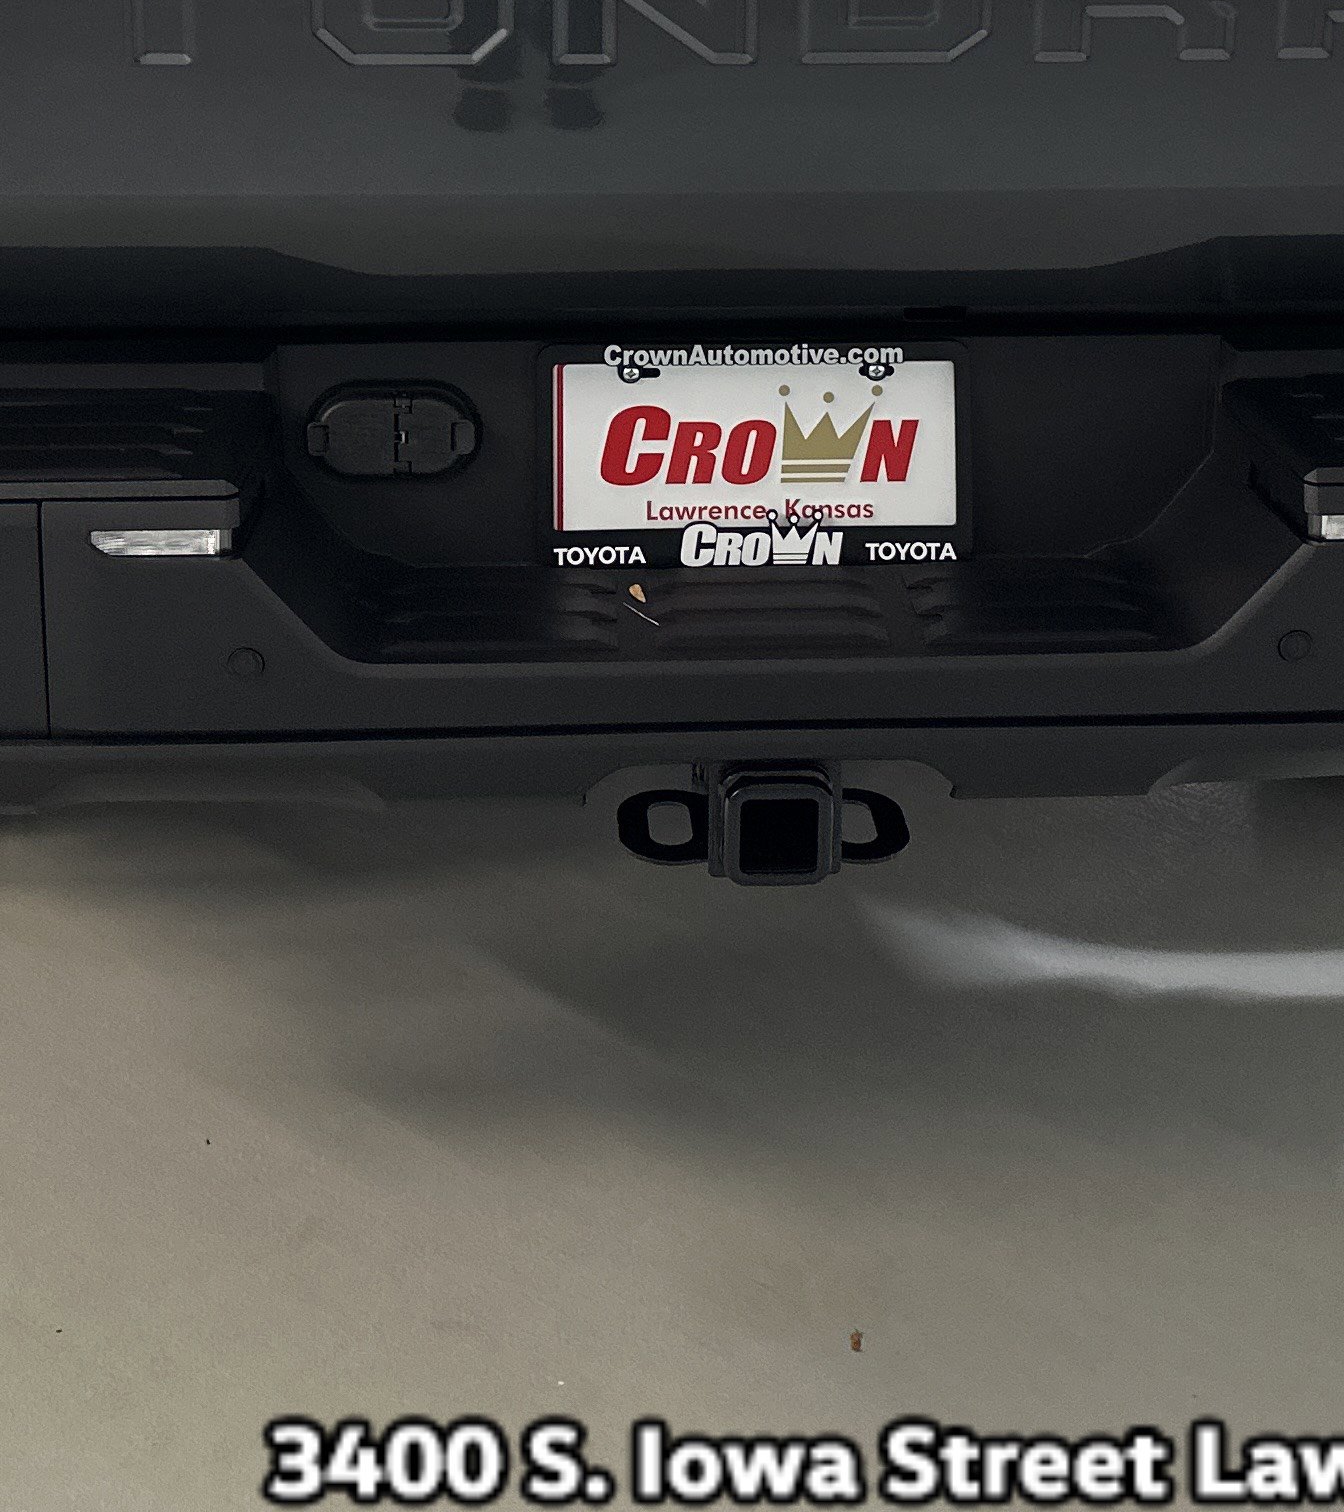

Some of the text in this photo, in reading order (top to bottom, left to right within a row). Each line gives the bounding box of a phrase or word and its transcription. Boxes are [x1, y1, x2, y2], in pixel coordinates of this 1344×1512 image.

[603, 343, 904, 367] CrownAutomotive.com
[554, 545, 647, 566] TOYOTA
[865, 541, 957, 562] TOYOTA
